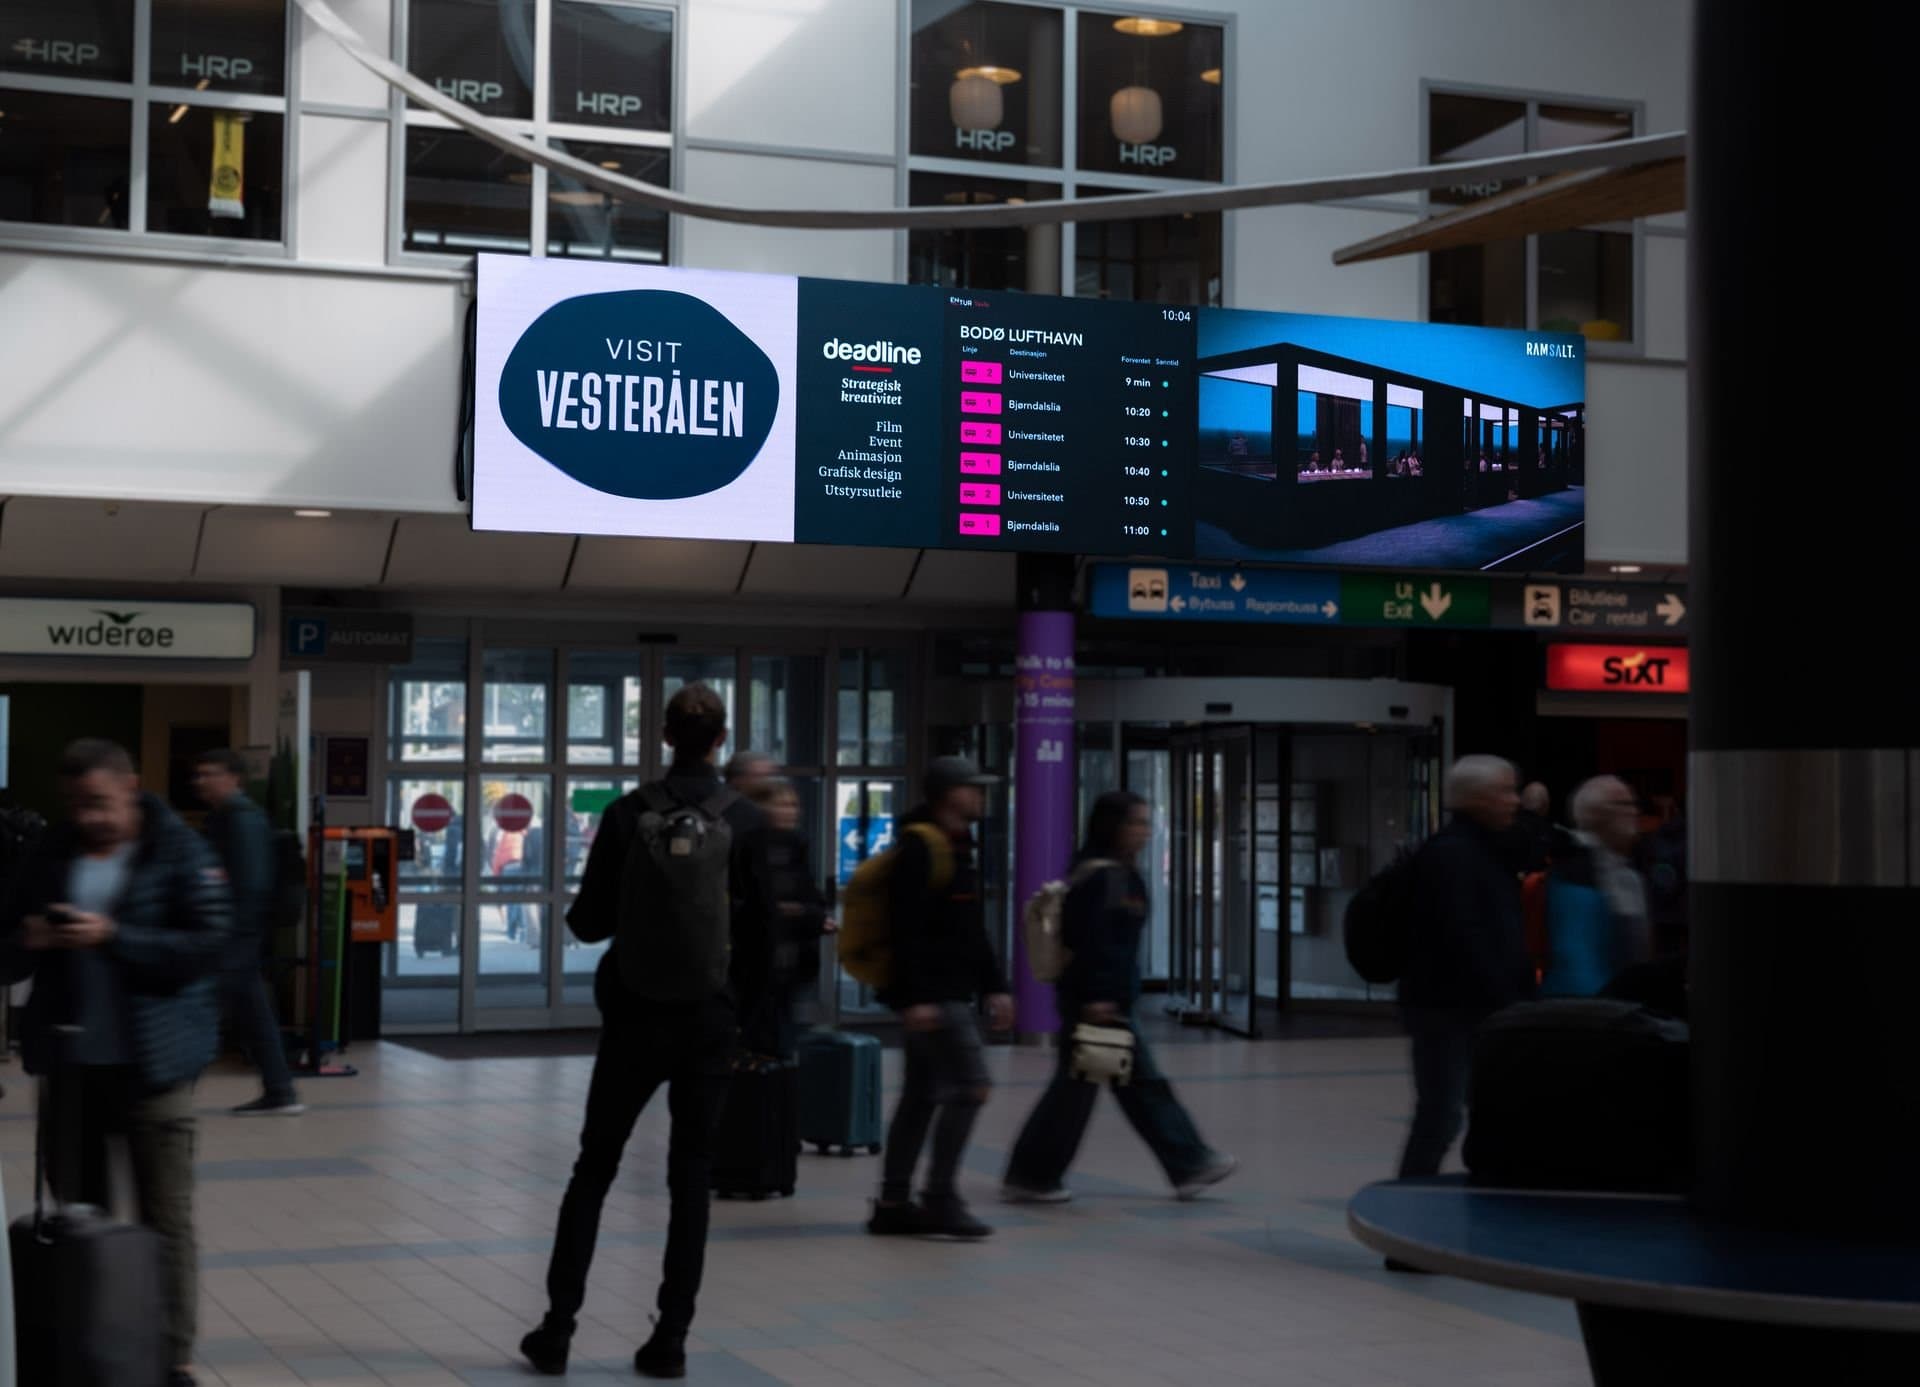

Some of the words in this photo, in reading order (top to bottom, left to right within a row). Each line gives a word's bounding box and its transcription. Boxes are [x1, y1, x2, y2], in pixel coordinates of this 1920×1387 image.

[25, 40, 100, 65] HRP
[180, 53, 254, 80] HRP
[435, 77, 504, 104] HRP
[576, 91, 642, 116] HRP
[955, 128, 1015, 152] HRP
[1119, 143, 1177, 167] HRP
[1162, 309, 1191, 322] 10:04
[960, 325, 1005, 341] BODØ
[1008, 329, 1083, 347] LUFTHAVN
[606, 337, 682, 363] VISIT
[823, 338, 922, 365] deadline
[962, 345, 978, 354] Linje
[1009, 348, 1047, 359] Destinasjon
[1526, 342, 1576, 359] RAMSALT.
[841, 377, 901, 393] Strategisk
[1009, 369, 1065, 382] Universitetet
[1125, 377, 1132, 387] 9
[1133, 378, 1151, 388] min
[536, 369, 744, 438] VESTERÅLEN
[840, 391, 902, 405] kreativitet
[1008, 400, 1061, 412] Bjørndalslia
[1125, 406, 1151, 417] 10:20
[876, 421, 903, 433] Film
[869, 436, 903, 448] Event
[1008, 430, 1065, 442] Universitetet
[1124, 436, 1151, 447] 10:30
[838, 449, 902, 464] Animasjon
[818, 465, 861, 479] Grafisk
[863, 467, 902, 482] design
[1008, 460, 1061, 472] Bjørndalslia
[1124, 466, 1150, 477] 10:40
[825, 484, 902, 499] Utstyrsutleie
[1007, 491, 1064, 503] Universitetet
[1123, 496, 1150, 507] 10:50
[1007, 520, 1060, 533] Bjørndalslia
[1123, 525, 1150, 536] 11:00
[1189, 571, 1222, 590] Taxi
[1395, 581, 1414, 600] Ut
[1189, 595, 1235, 611] Bybuss
[1245, 597, 1318, 616] Regionbuss
[1383, 601, 1414, 620] Exit
[1568, 609, 1596, 625] Car
[1606, 610, 1648, 627] rental
[48, 620, 174, 648] widerøe
[296, 624, 319, 652] P
[329, 629, 410, 646] AUTOMAT
[1023, 692, 1039, 707] 15
